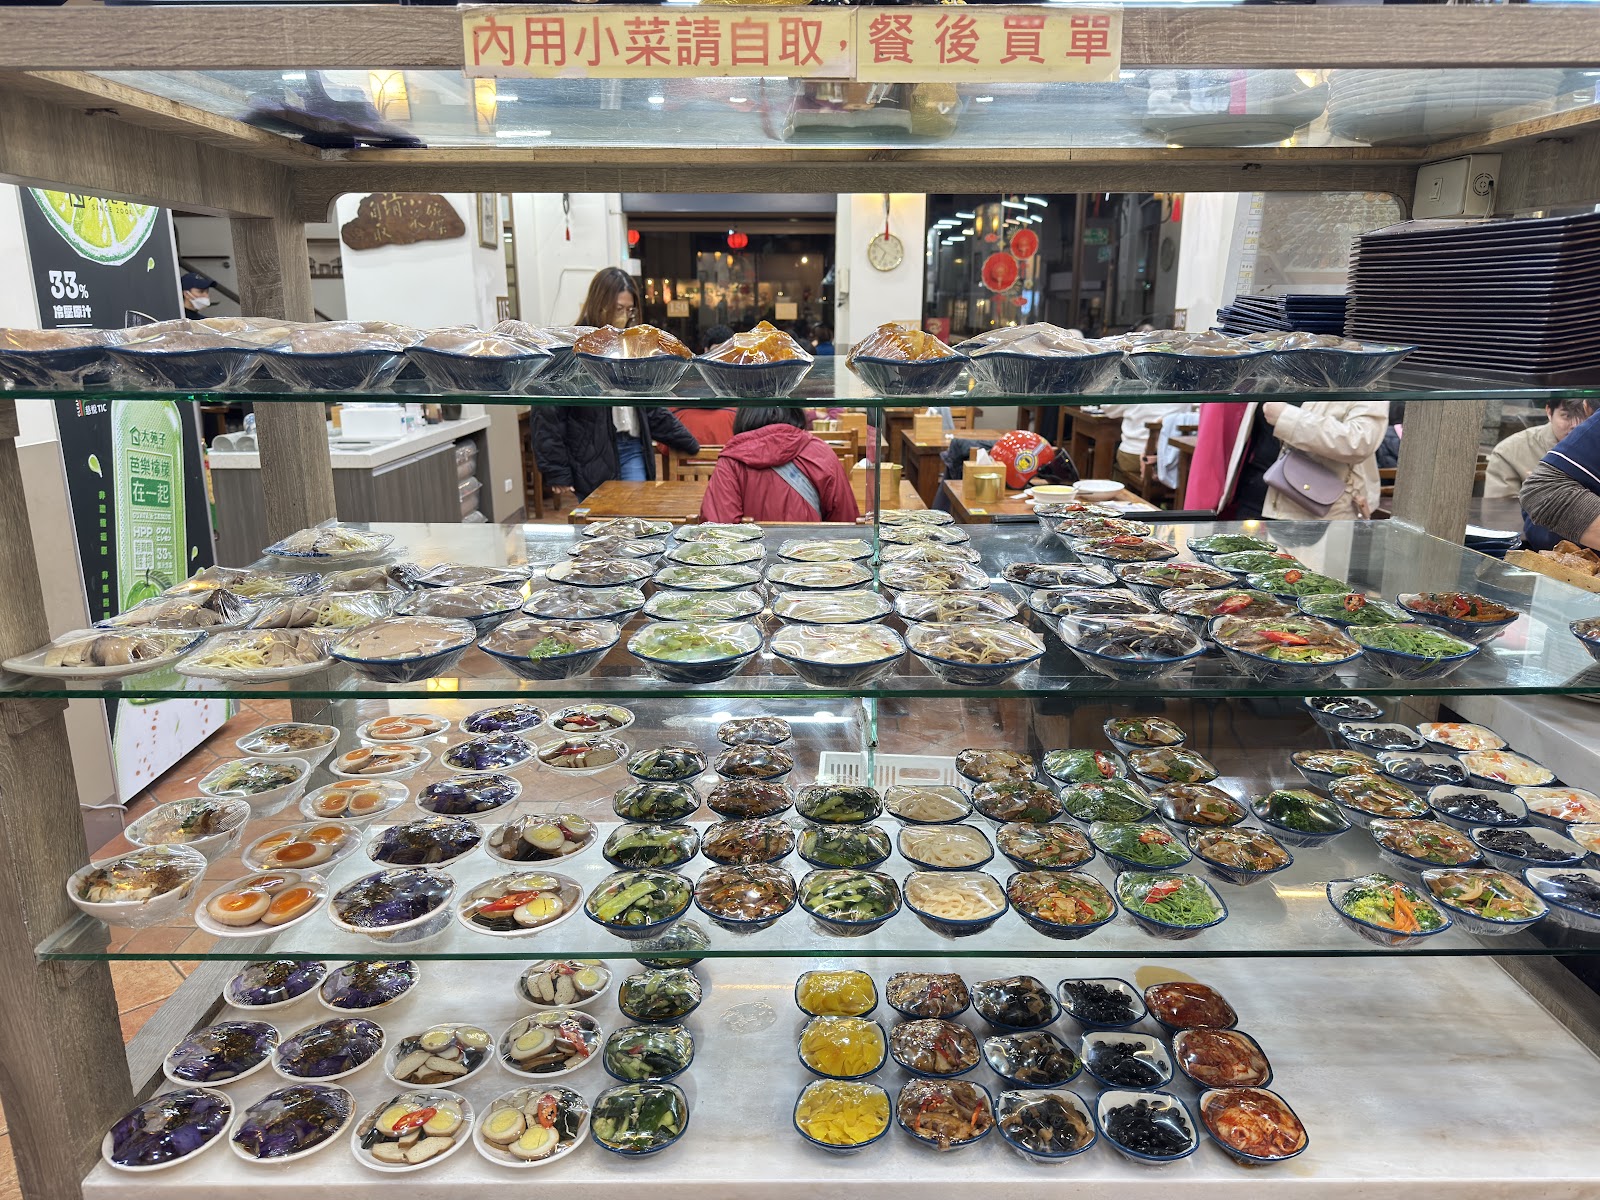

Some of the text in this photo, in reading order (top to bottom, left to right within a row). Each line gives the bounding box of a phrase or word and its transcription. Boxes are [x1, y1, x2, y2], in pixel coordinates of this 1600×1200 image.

[868, 12, 1112, 65] 餐後買單
[48, 270, 89, 299] 33%
[141, 429, 166, 446] 大苑子
[129, 456, 171, 478] 芭樂檸檬
[132, 480, 170, 504] 在一起
[133, 526, 153, 538] HPP
